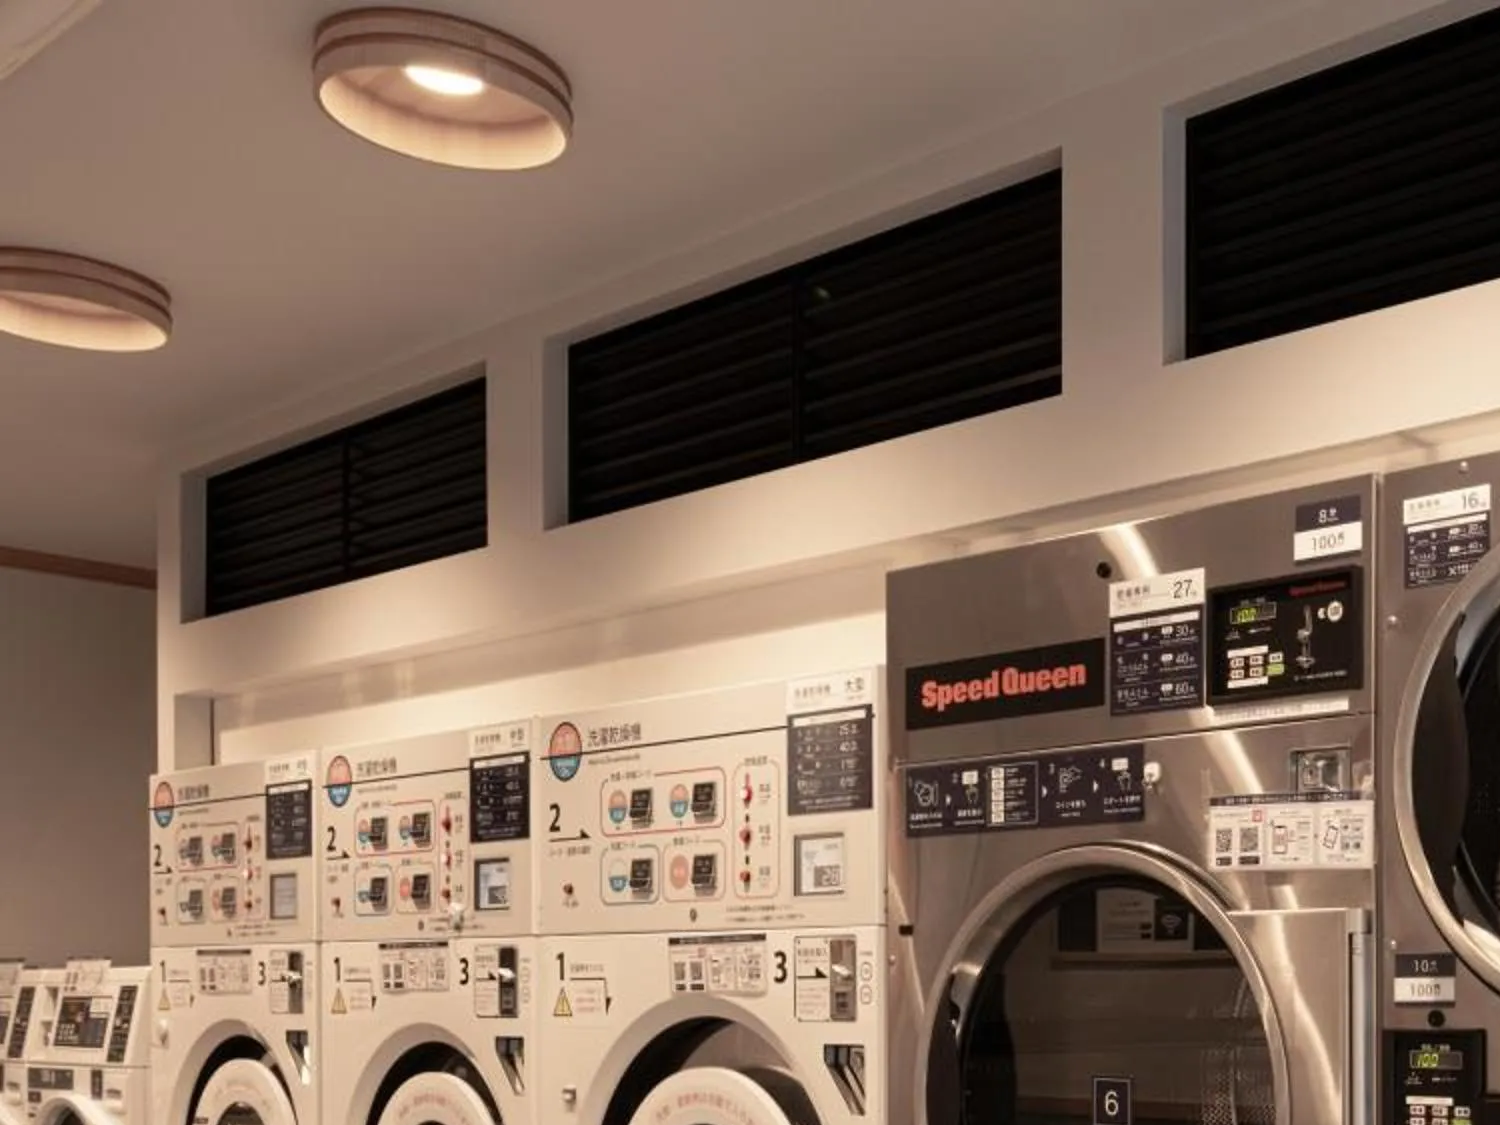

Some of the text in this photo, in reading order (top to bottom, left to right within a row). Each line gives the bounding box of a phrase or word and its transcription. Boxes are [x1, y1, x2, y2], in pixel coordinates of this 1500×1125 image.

[921, 668, 999, 711] Speed
[1002, 662, 1087, 697] Queen
[549, 803, 561, 833] 2
[326, 826, 337, 852] 2
[154, 844, 162, 867] 2
[160, 959, 166, 983] 1
[258, 961, 266, 986] 3
[334, 956, 341, 982] 1
[459, 957, 469, 985] 3
[556, 952, 565, 981] 1
[773, 950, 788, 983] 3
[1104, 1090, 1119, 1117] 6
